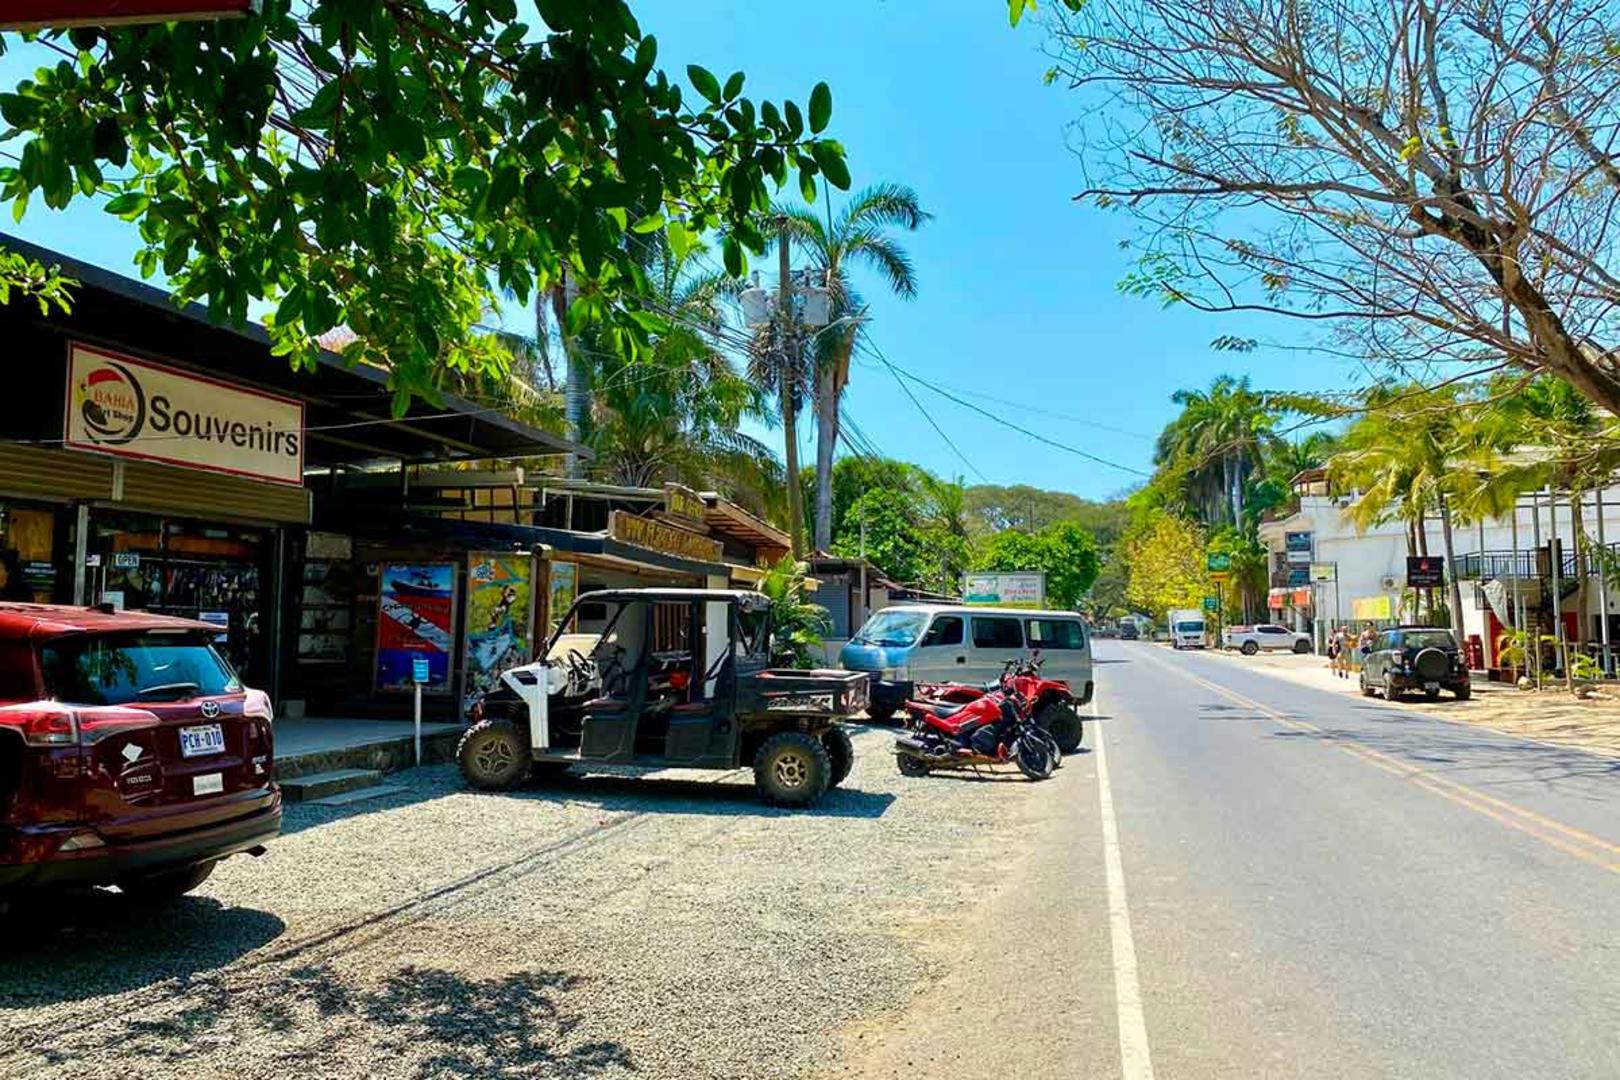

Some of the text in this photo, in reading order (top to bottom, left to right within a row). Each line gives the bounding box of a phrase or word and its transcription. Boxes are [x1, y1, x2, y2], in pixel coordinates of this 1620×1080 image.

[149, 395, 299, 457] Souvenirs
[115, 553, 140, 567] OPEN
[181, 730, 222, 750] PCH-010
